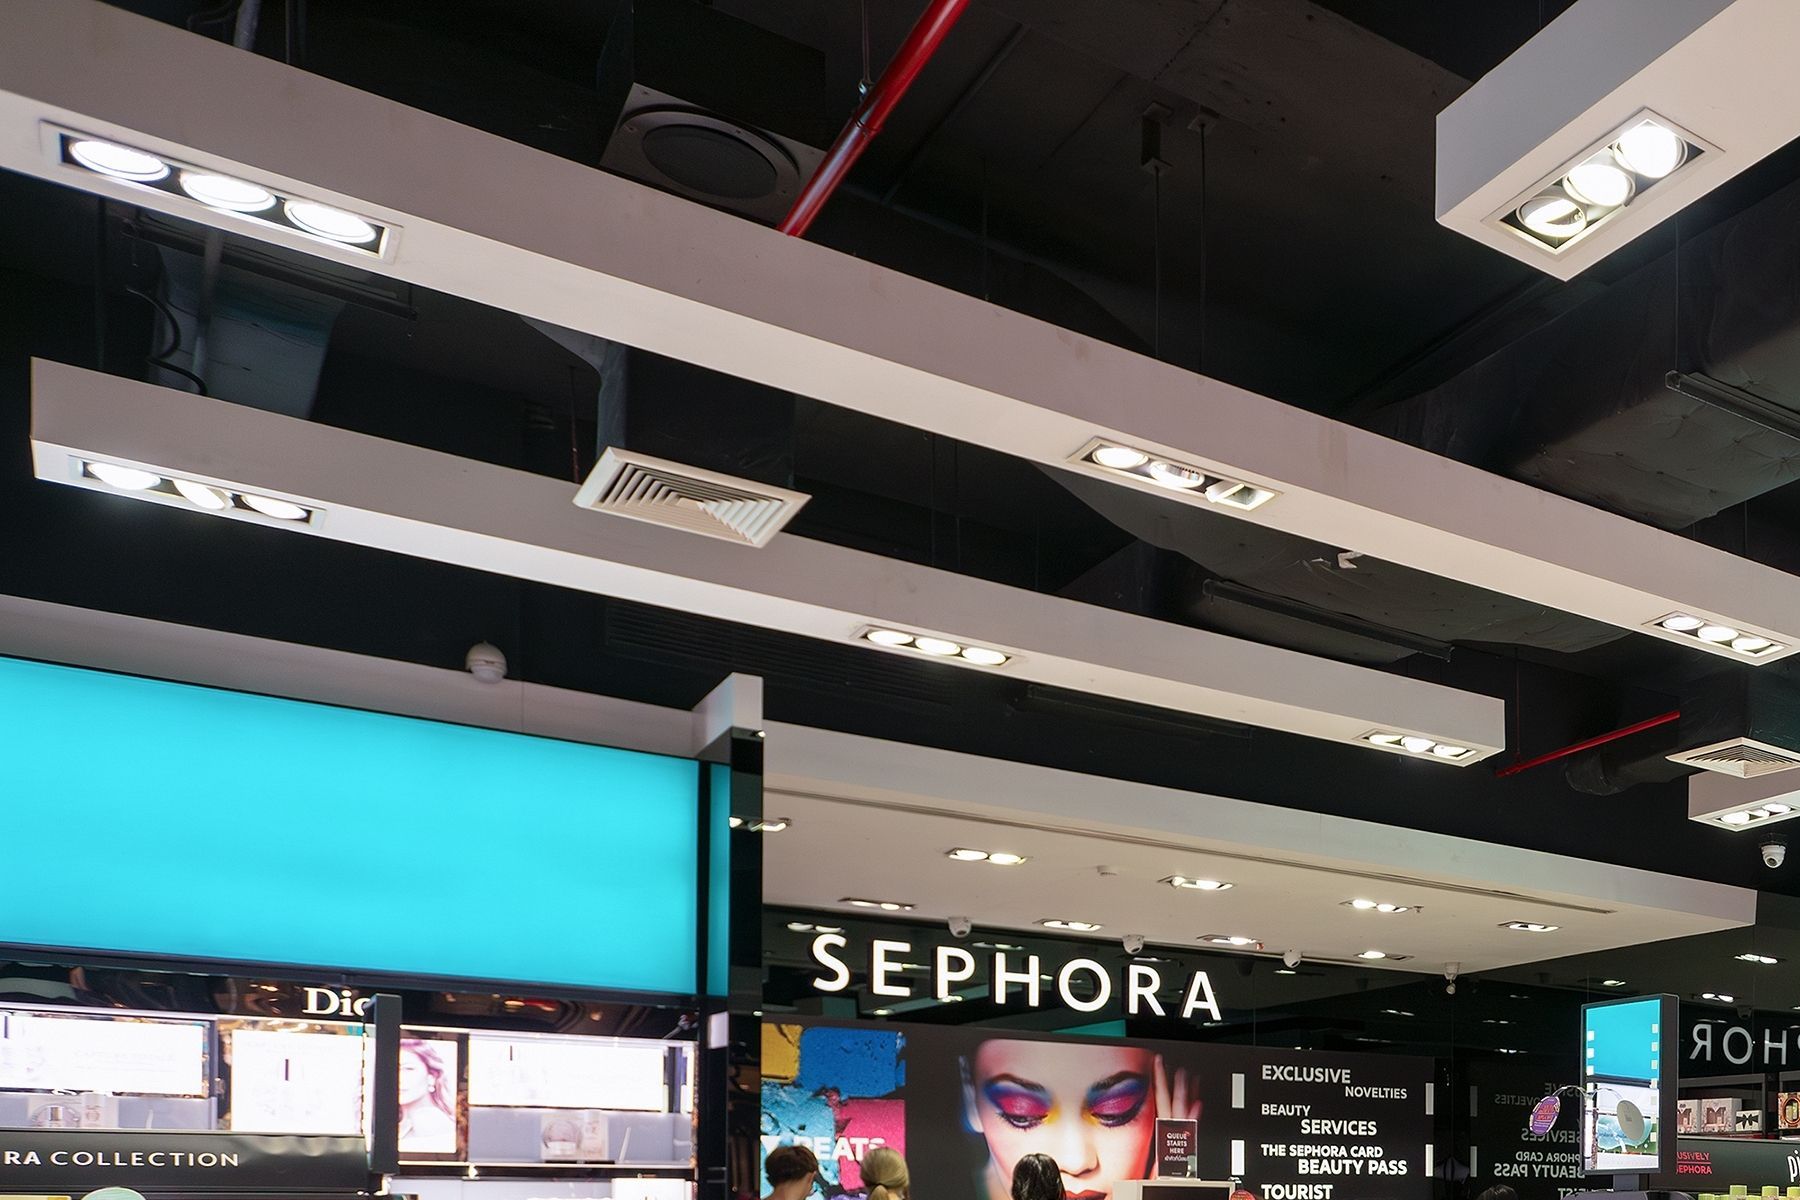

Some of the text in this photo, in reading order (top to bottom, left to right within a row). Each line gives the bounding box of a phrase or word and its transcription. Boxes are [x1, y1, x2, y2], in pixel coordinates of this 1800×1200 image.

[811, 932, 1222, 1021] SEPHORA
[1261, 1064, 1351, 1085] EXCLUSIVE
[1345, 1085, 1408, 1100] NOVELTIES
[1261, 1103, 1311, 1117] BEAUTY
[1166, 1132, 1188, 1140] QUEUE
[1300, 1119, 1378, 1136] SERVICES
[50, 1150, 240, 1168] COLLECTION
[1260, 1143, 1384, 1159] THE SEPHORA CARD
[1298, 1158, 1408, 1176] BEAUTY PASS
[1260, 1183, 1334, 1200] TOURIST
